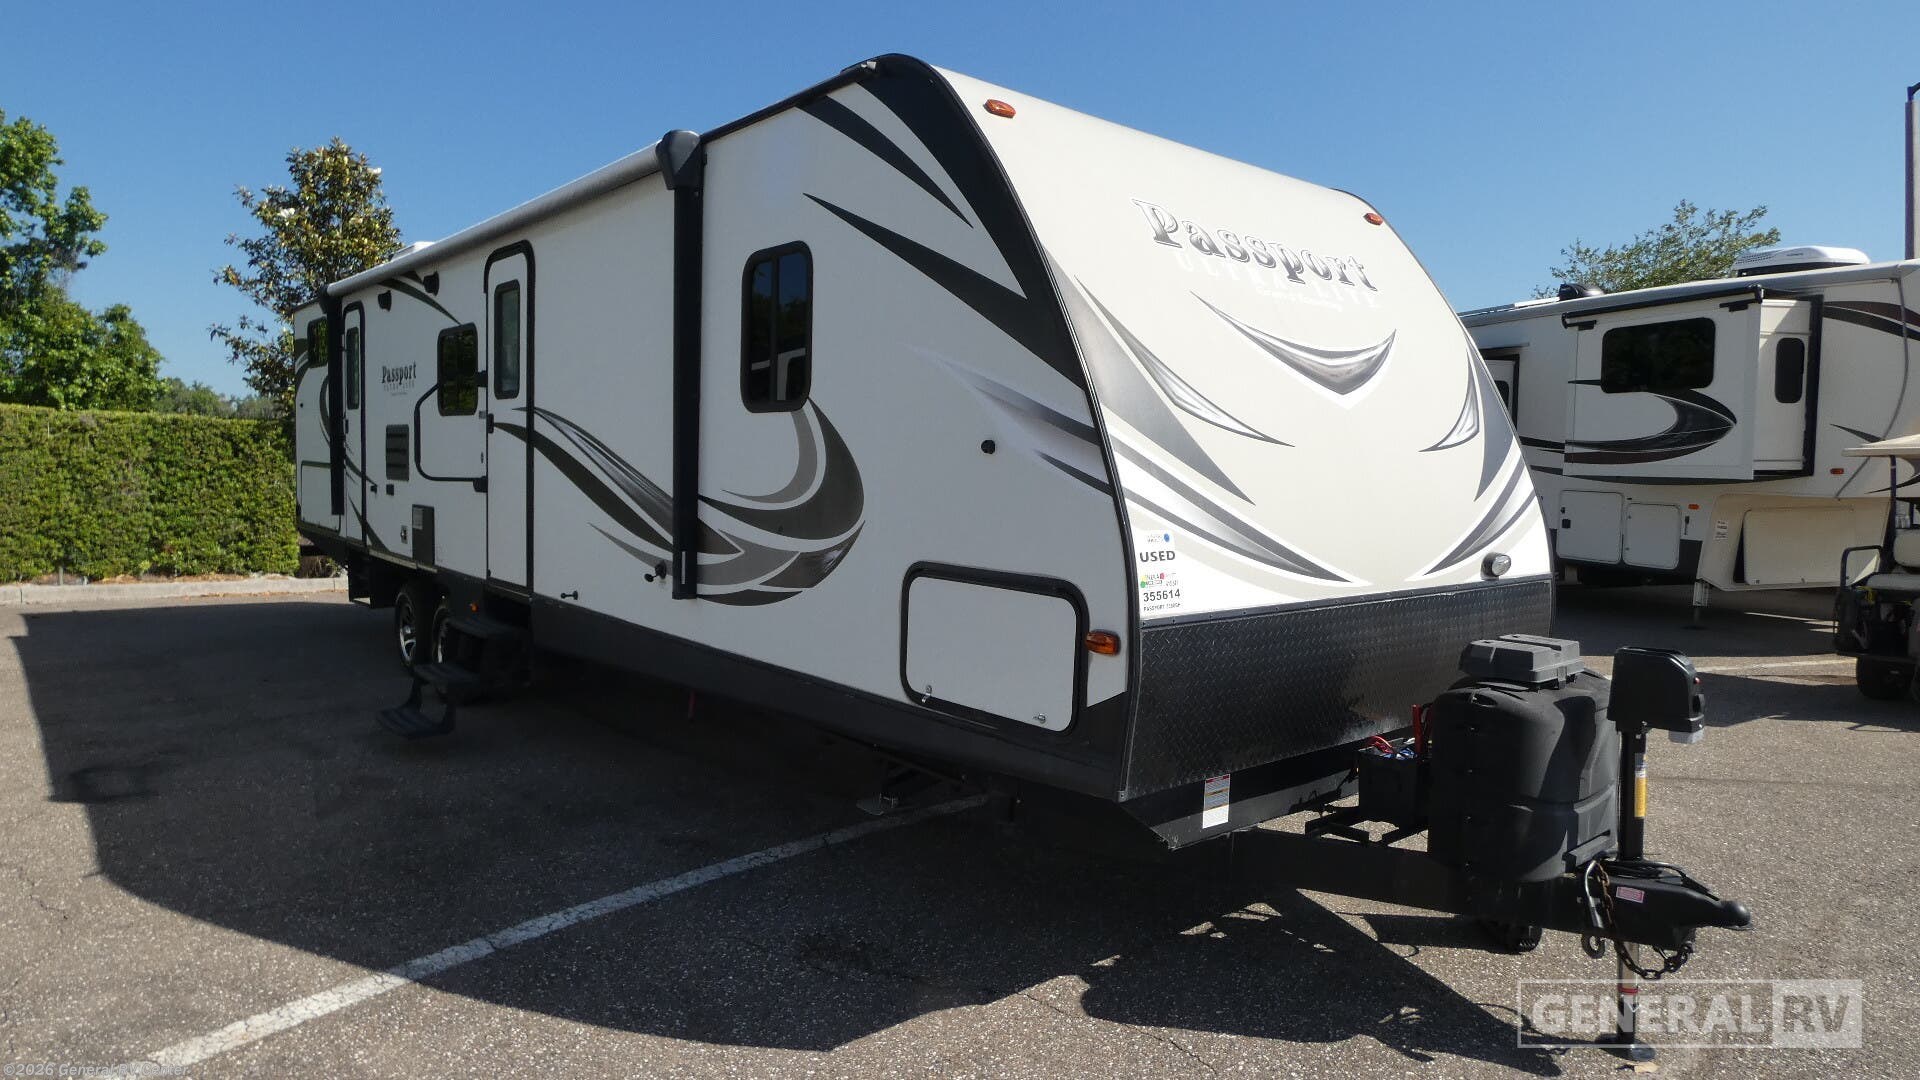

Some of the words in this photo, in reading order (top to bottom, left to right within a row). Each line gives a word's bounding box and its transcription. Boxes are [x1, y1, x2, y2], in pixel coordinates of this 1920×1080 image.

[1131, 198, 1378, 291] Passport
[381, 360, 417, 385] Passport
[1139, 550, 1176, 562] USED
[1143, 588, 1181, 602] 355614
